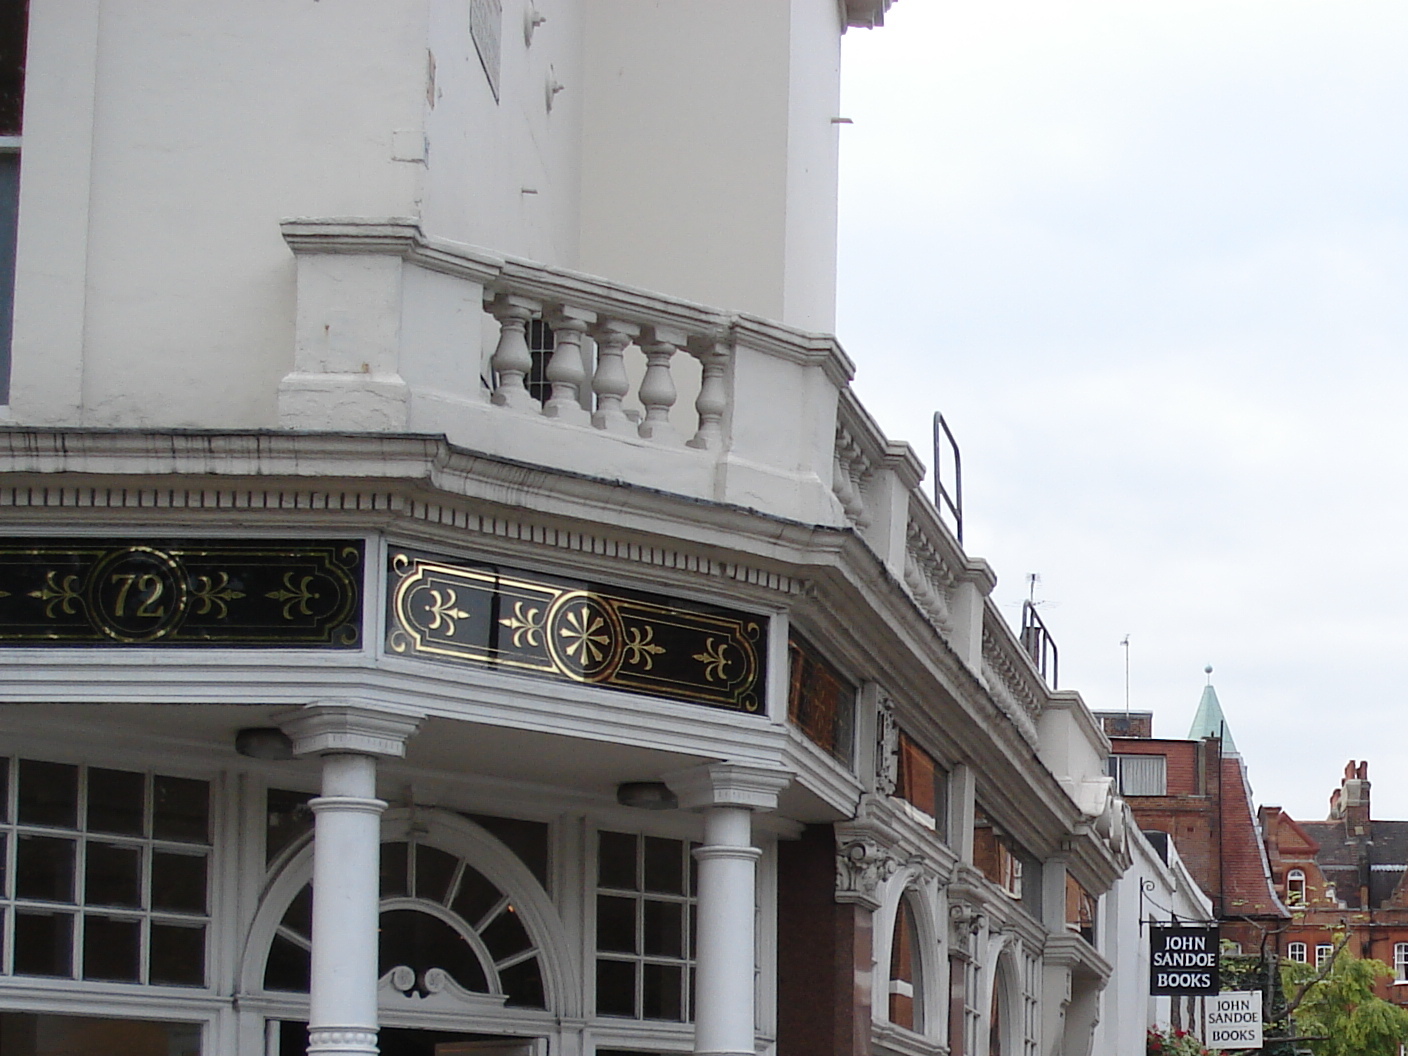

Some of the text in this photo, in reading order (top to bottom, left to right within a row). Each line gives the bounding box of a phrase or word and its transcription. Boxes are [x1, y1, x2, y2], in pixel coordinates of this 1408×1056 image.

[111, 574, 165, 617] 72
[1165, 936, 1206, 951] JOHN
[1153, 952, 1216, 967] SANDOE
[1157, 973, 1211, 988] BOOKS
[1217, 1000, 1250, 1012] JOHN
[1208, 1012, 1259, 1024] SANDOE
[1212, 1030, 1256, 1041] BOOKS
